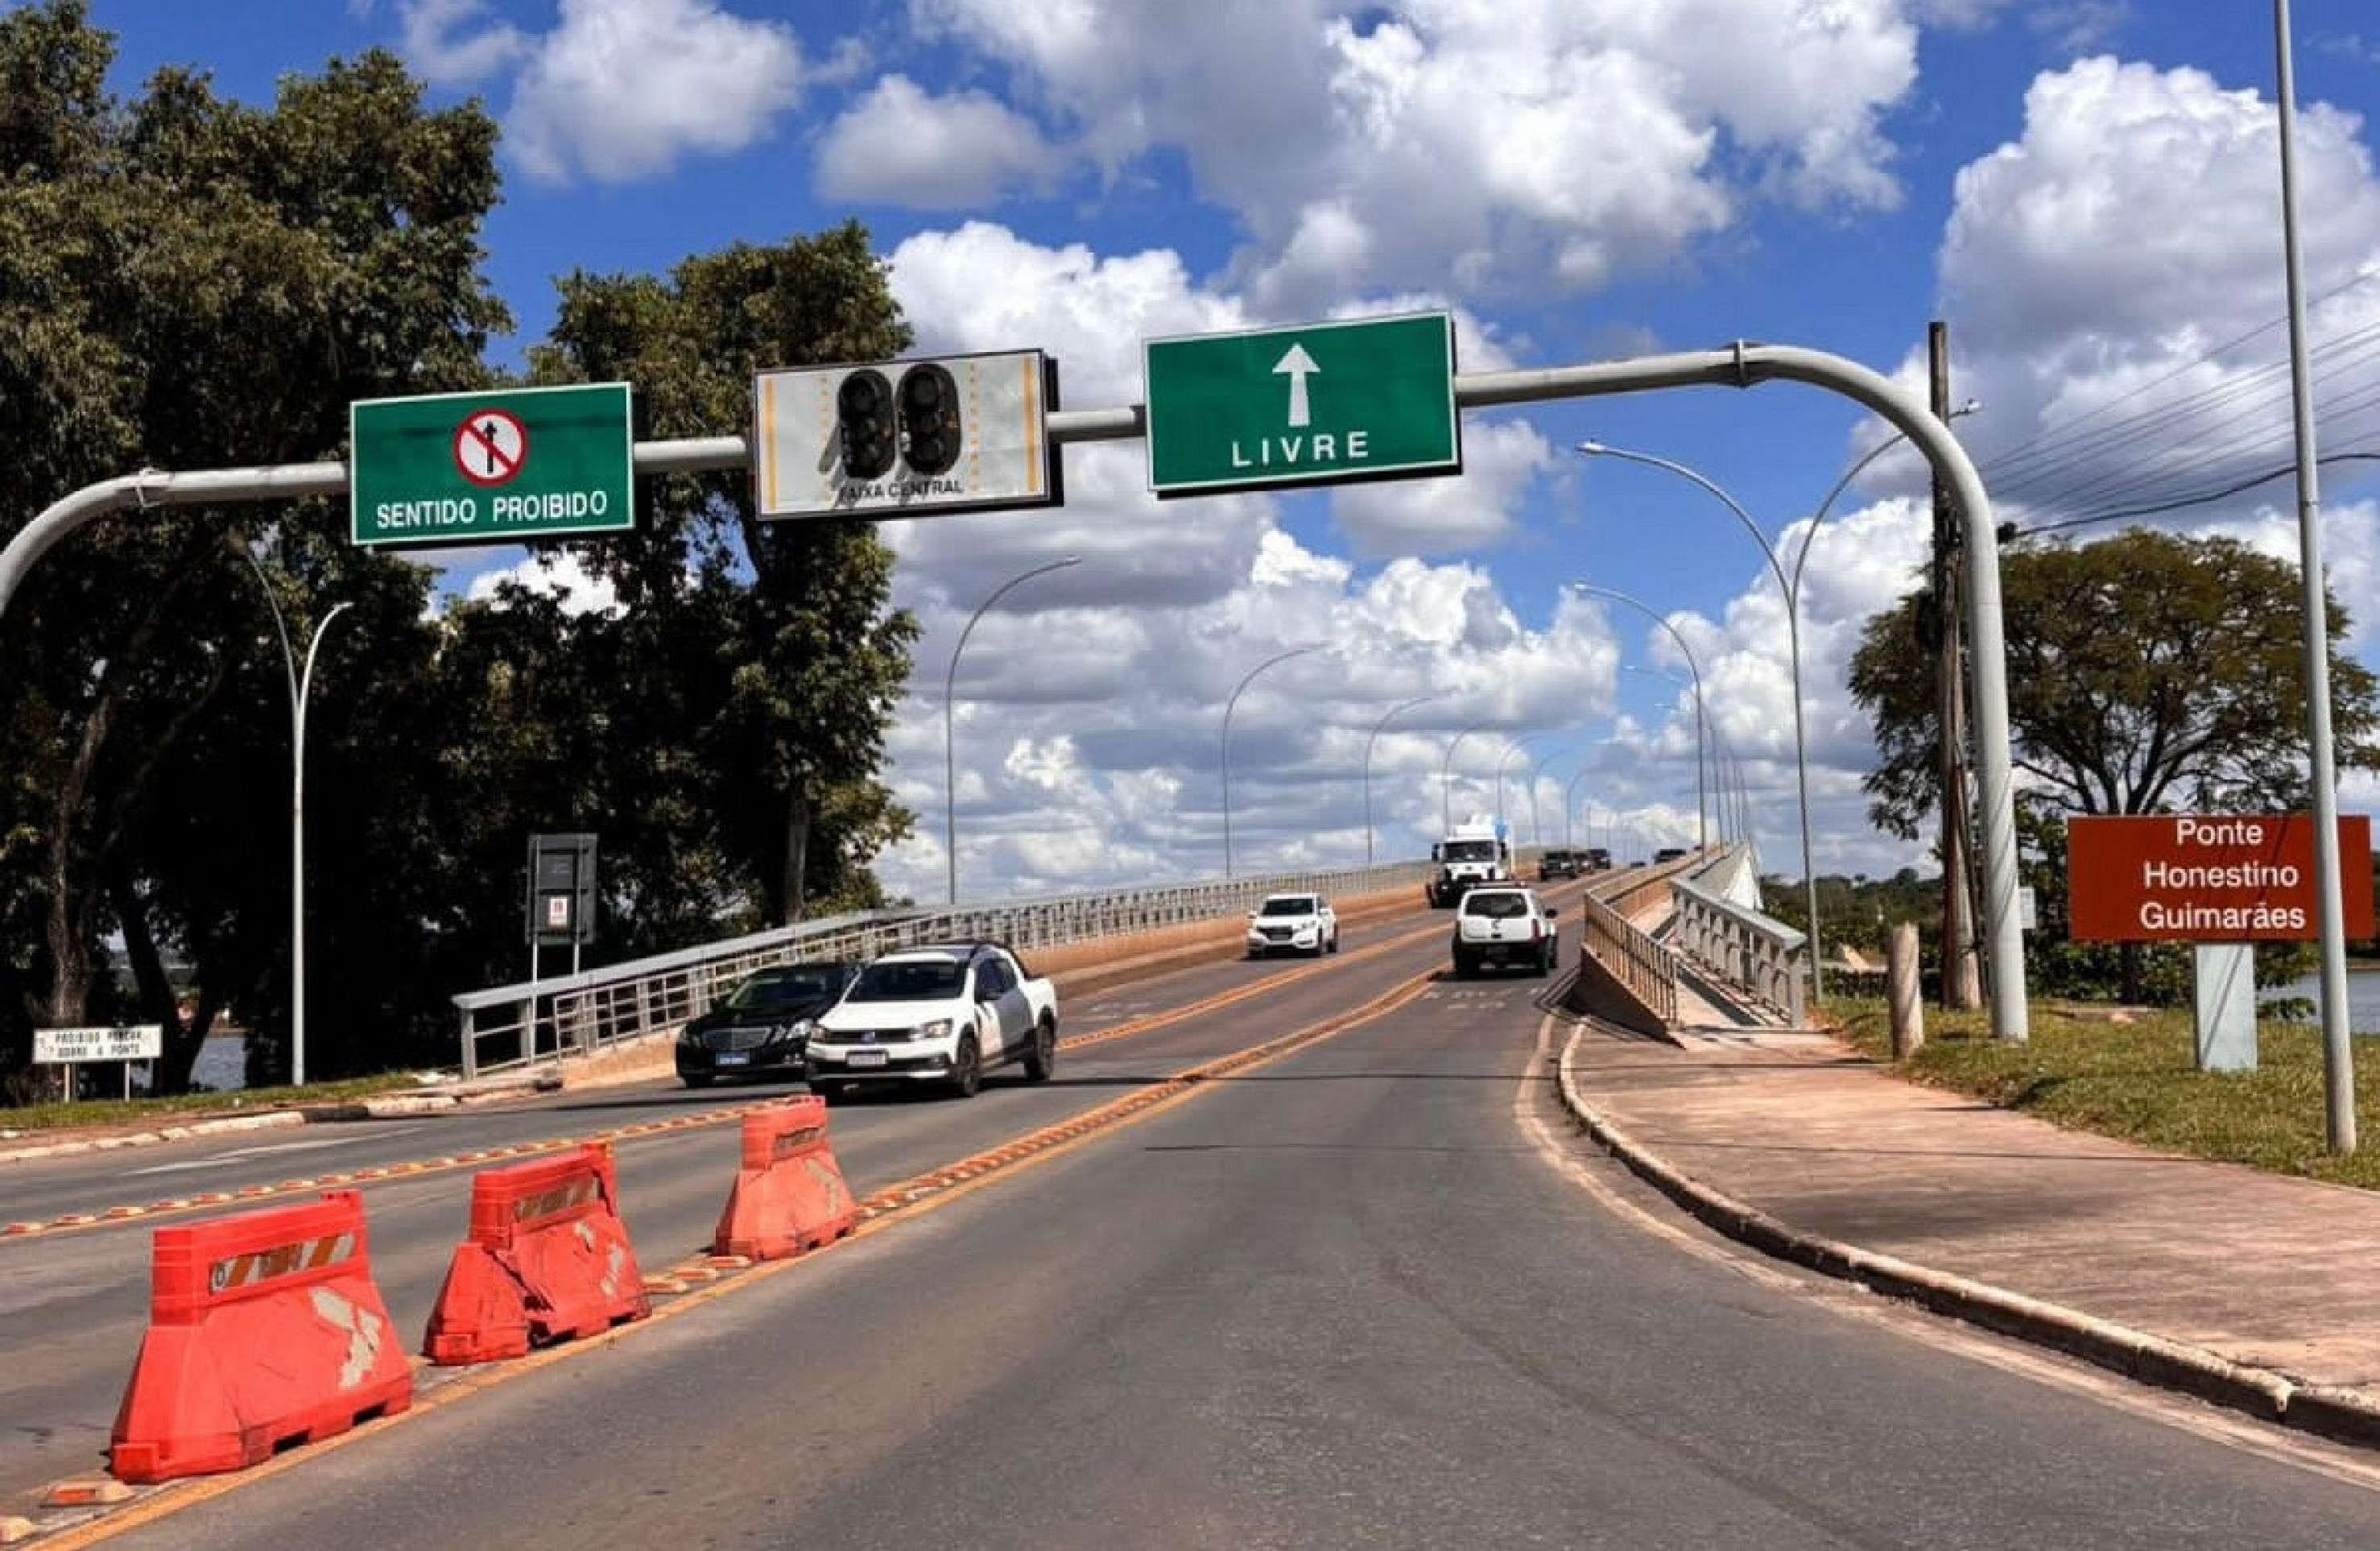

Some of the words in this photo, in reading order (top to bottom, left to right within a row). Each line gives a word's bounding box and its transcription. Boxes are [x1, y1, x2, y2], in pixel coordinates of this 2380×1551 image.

[1232, 431, 1368, 467] LIVRE
[888, 480, 965, 498] CENTRAL
[377, 498, 477, 529] SENTIDO
[493, 490, 606, 522] PROIBIDO
[2176, 818, 2263, 846] Ponte
[2143, 860, 2299, 888] Honestino
